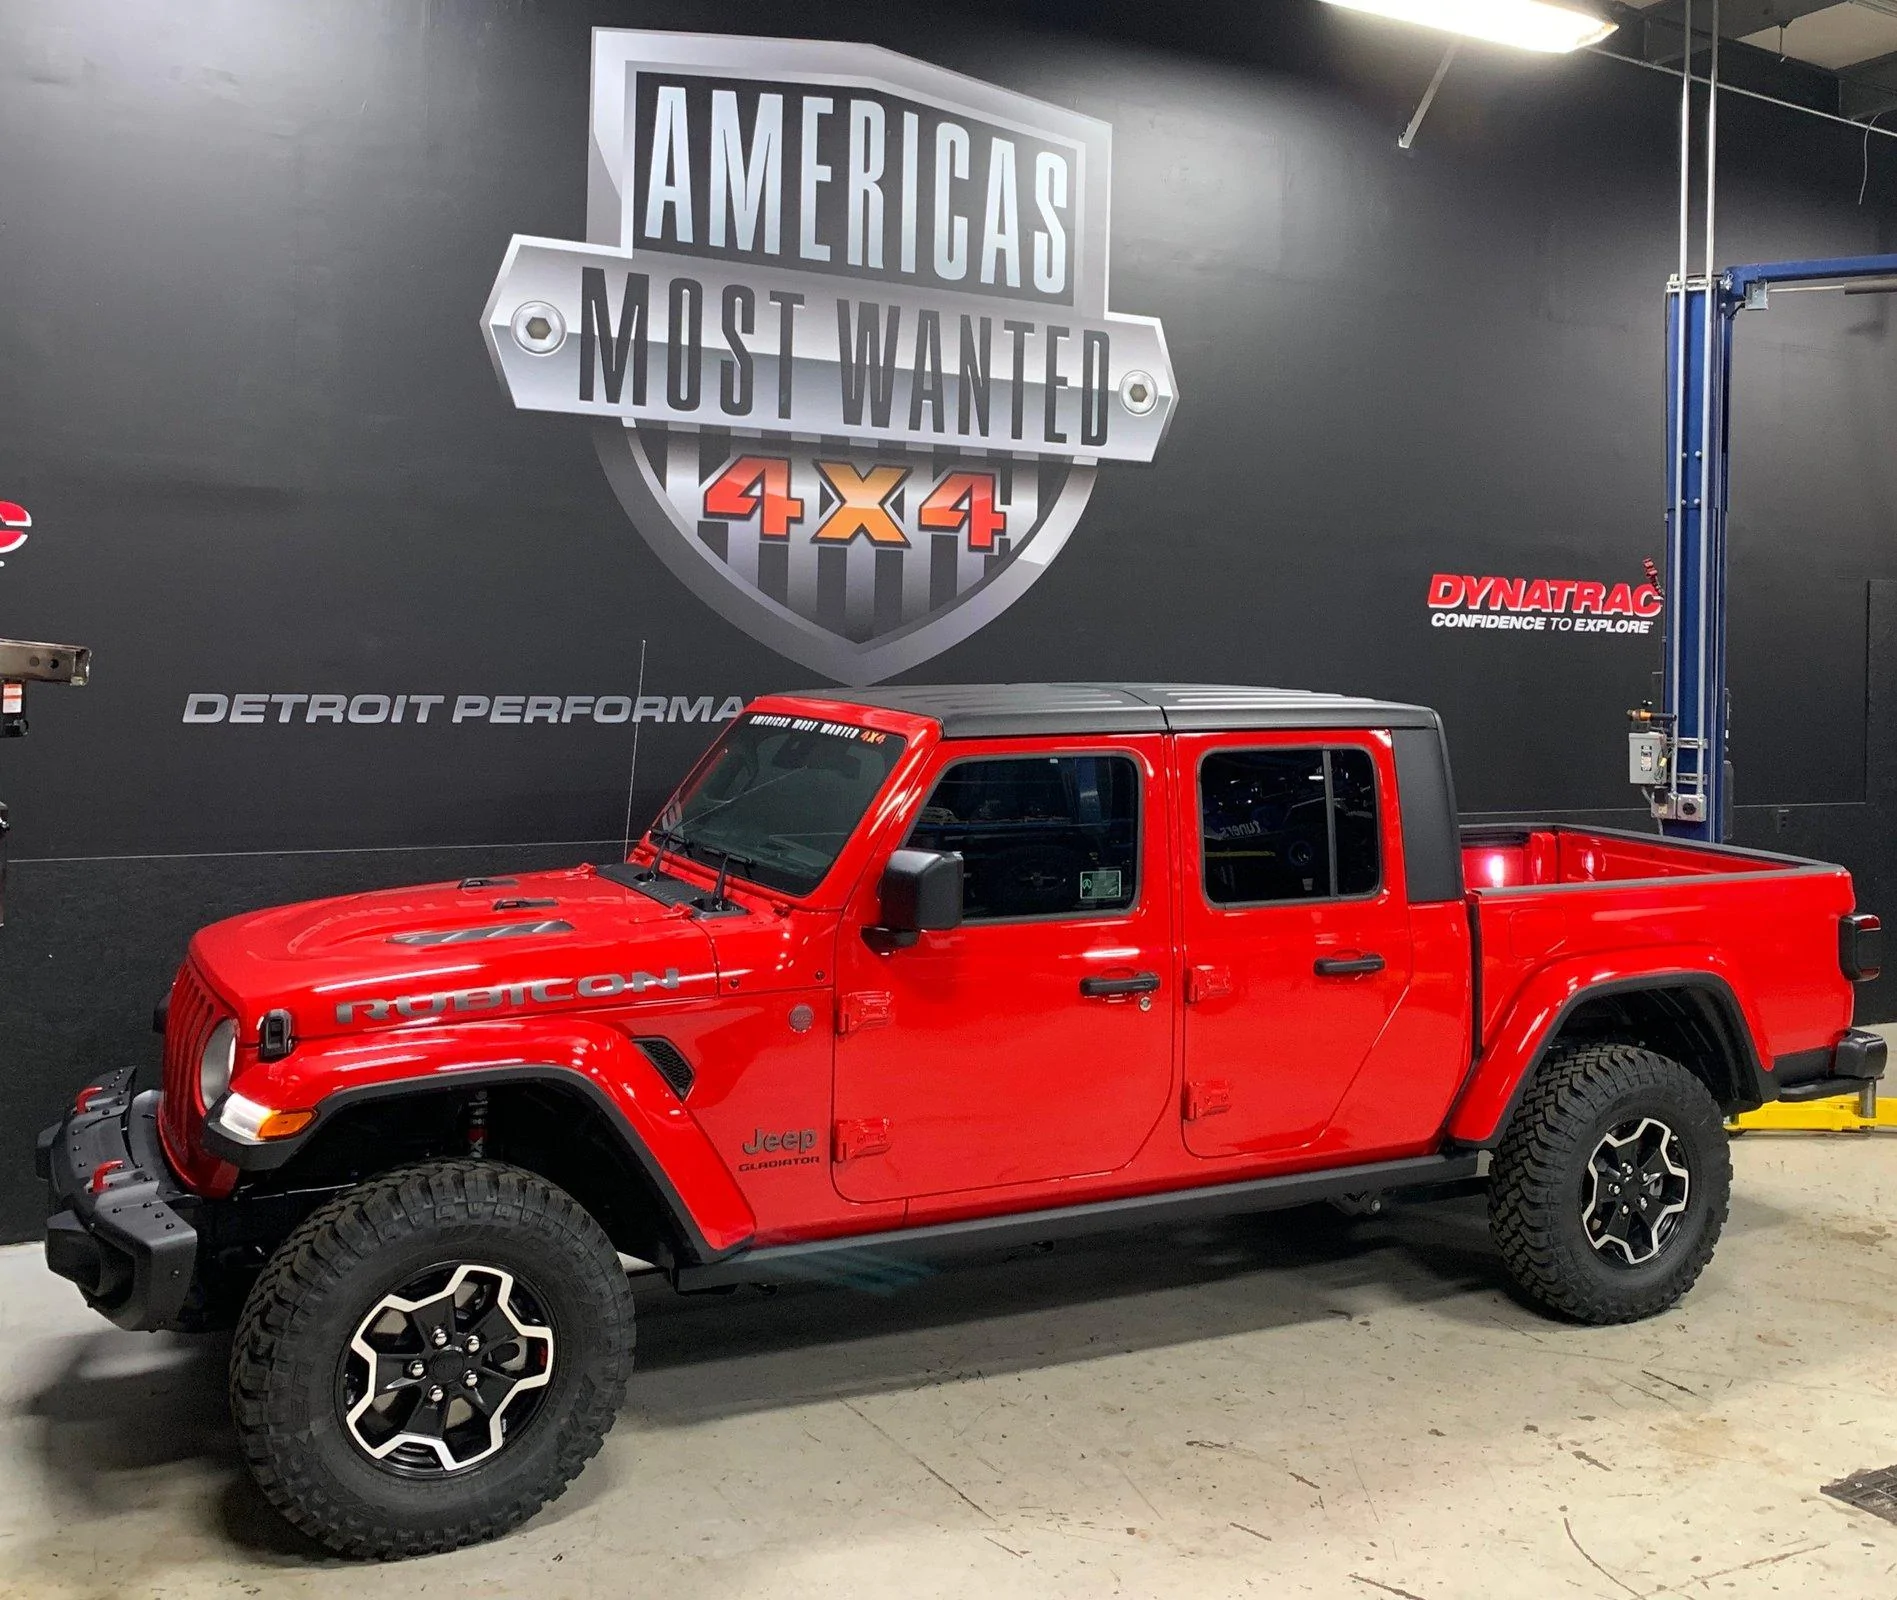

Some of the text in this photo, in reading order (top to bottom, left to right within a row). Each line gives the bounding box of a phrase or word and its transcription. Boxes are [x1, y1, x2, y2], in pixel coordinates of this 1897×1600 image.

[645, 86, 1069, 294] AMERICAS
[578, 267, 1110, 448] MOST WANTED
[702, 454, 1007, 551] 4X4
[1427, 573, 1664, 617] DYNATRAC
[1431, 612, 1651, 634] CONFIDENCE TO EXPLORE
[182, 692, 445, 724] DETROIT
[750, 715, 886, 744] AMERICAS MOST WANTED 4X4
[335, 968, 680, 1024] RUBICON
[742, 1127, 817, 1155] Jeep
[738, 1156, 820, 1172] GLADIATOR
